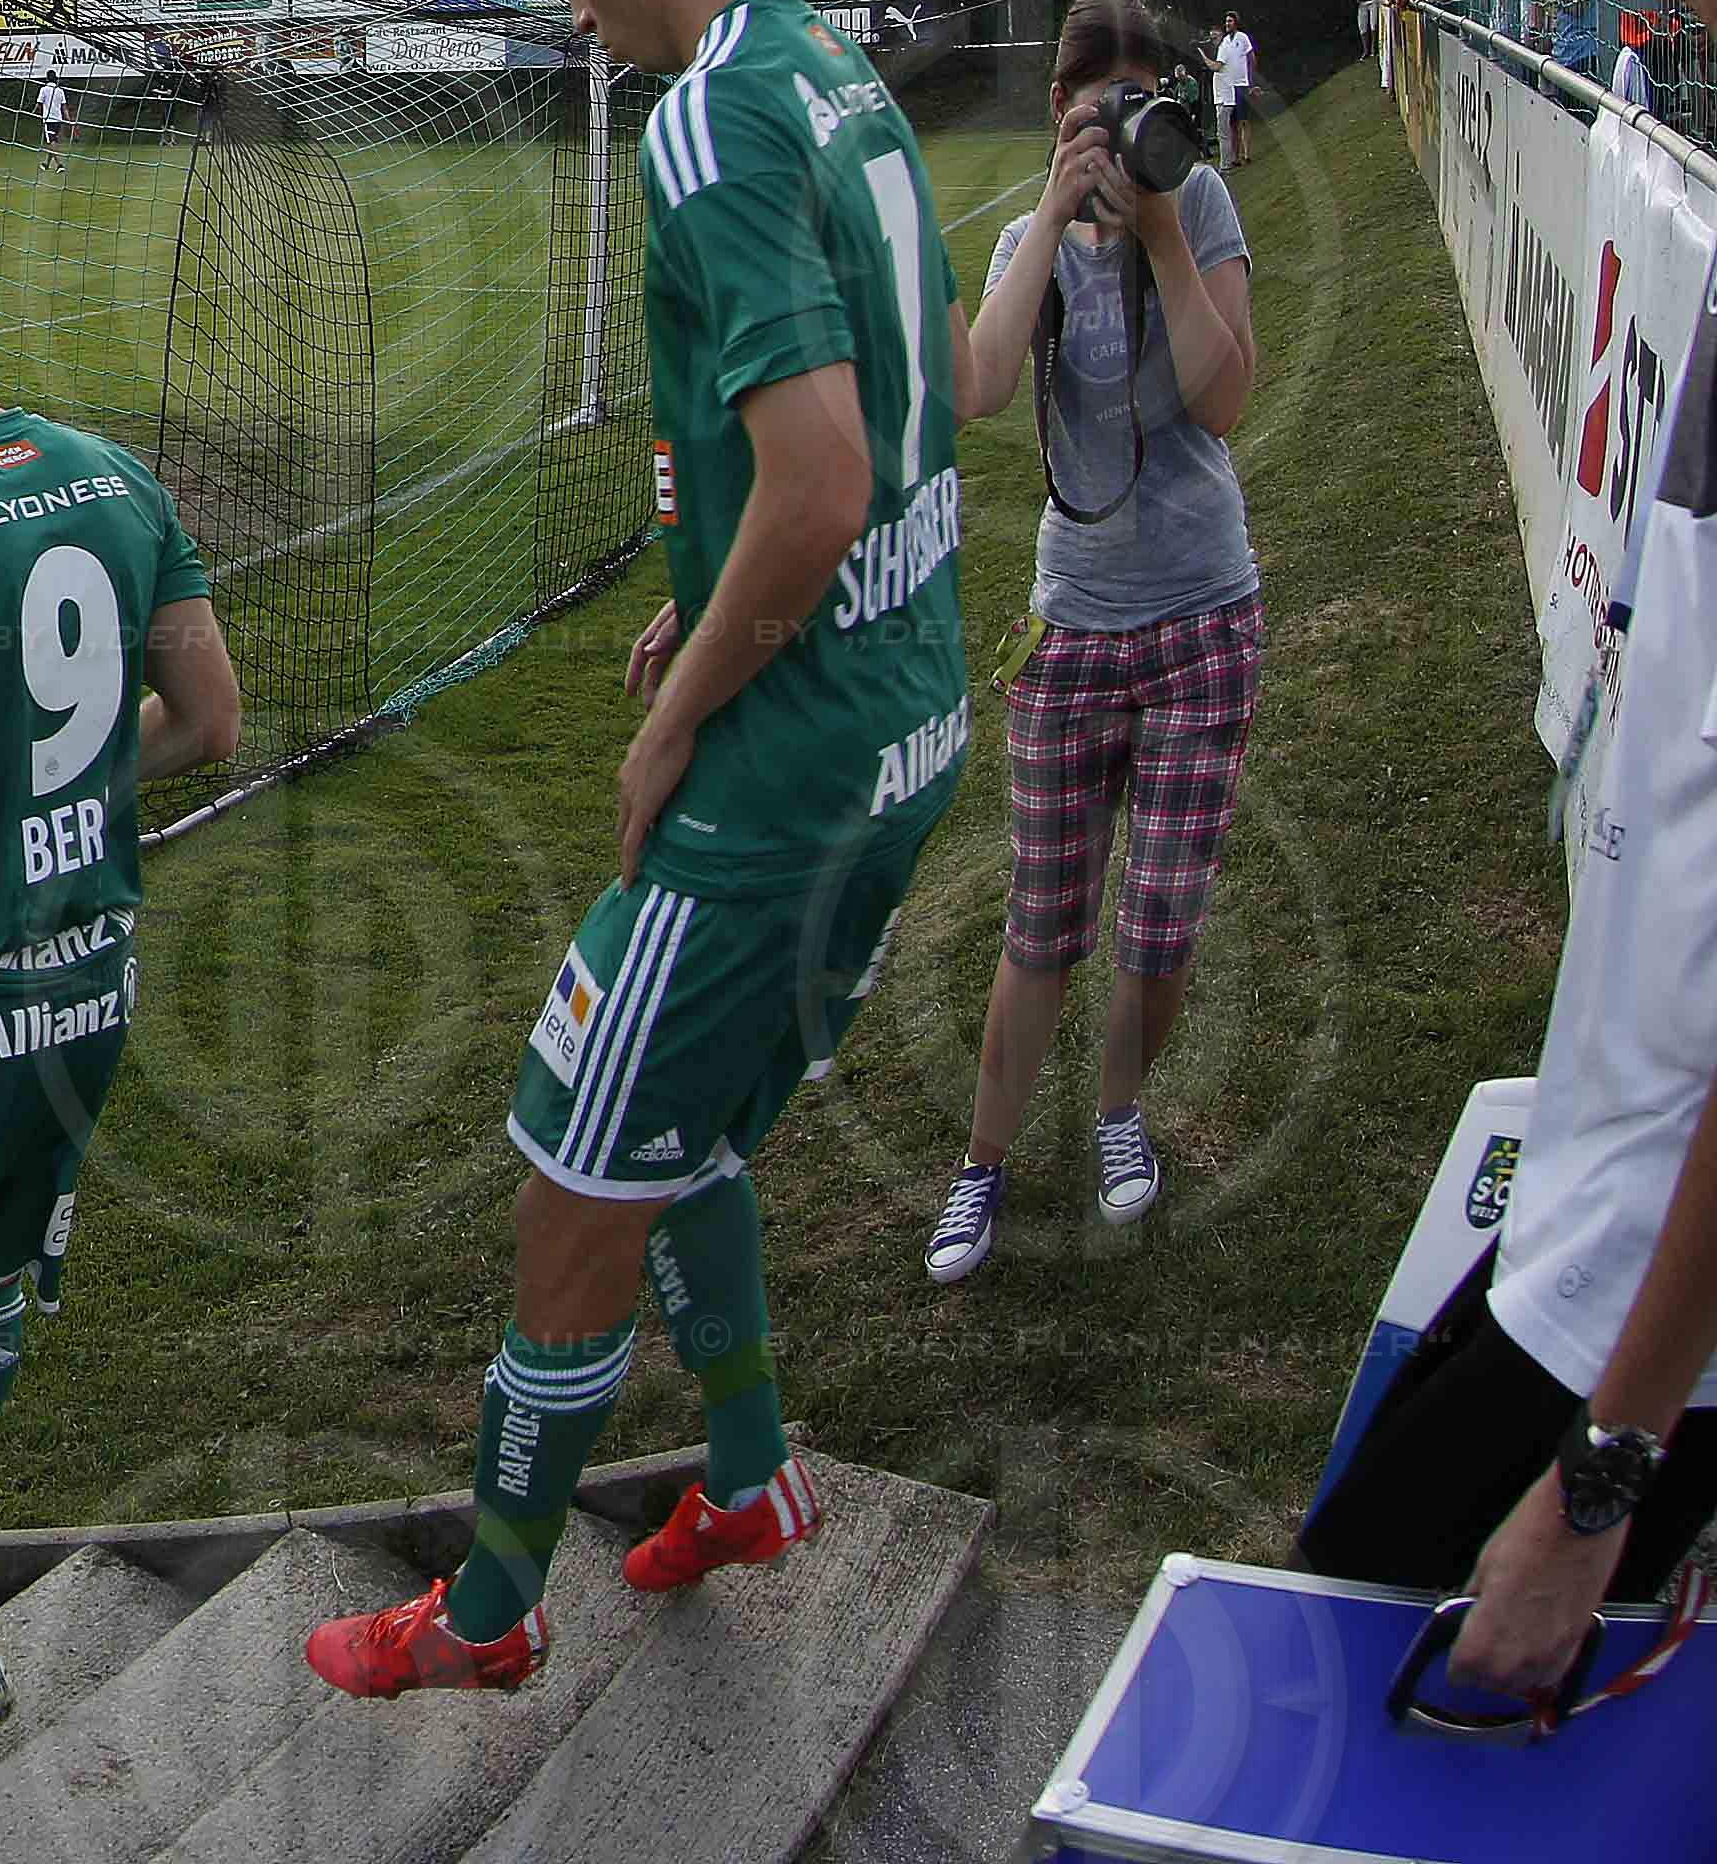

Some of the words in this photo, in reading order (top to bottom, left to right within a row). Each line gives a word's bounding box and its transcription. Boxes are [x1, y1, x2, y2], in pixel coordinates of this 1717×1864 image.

[392, 38, 428, 60] Don
[862, 148, 927, 488] 1
[20, 545, 126, 797] 9
